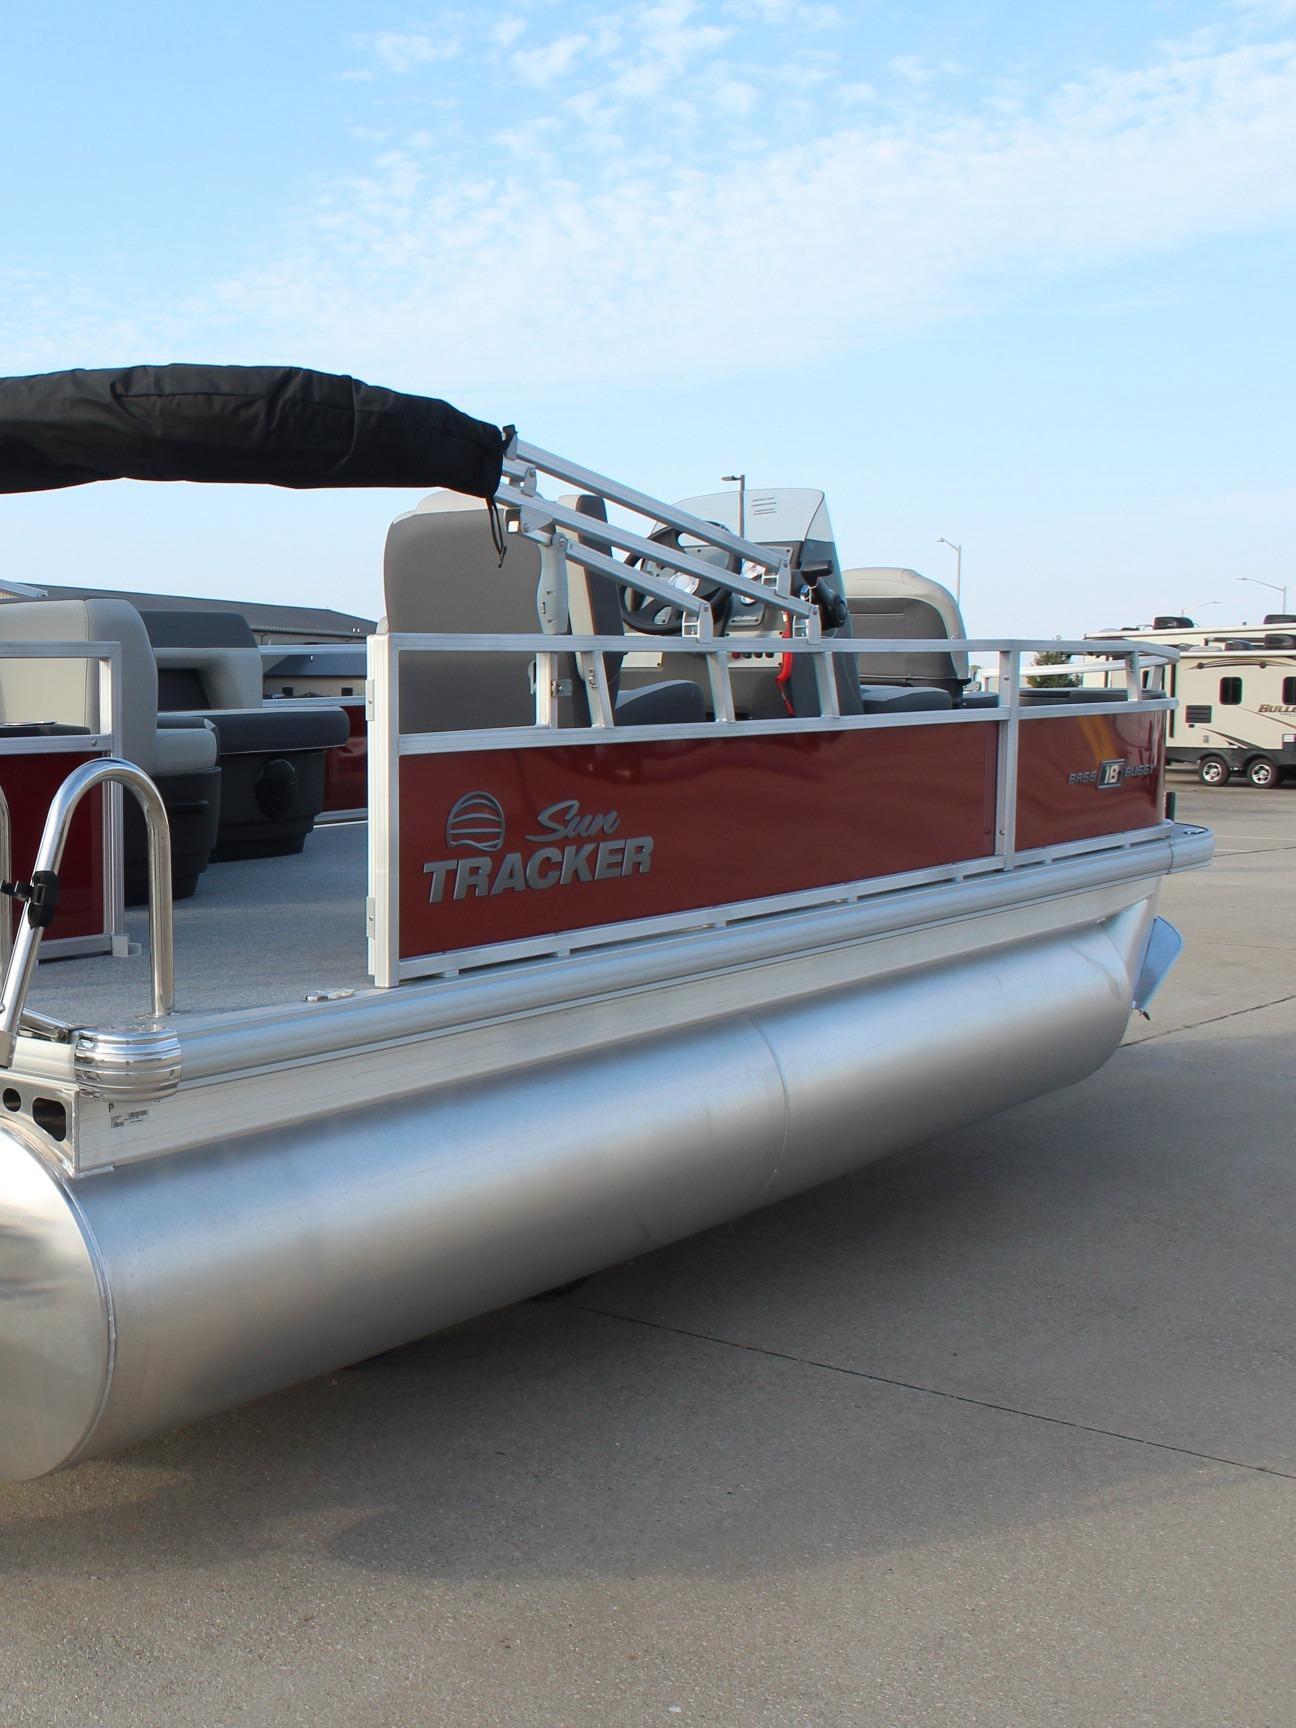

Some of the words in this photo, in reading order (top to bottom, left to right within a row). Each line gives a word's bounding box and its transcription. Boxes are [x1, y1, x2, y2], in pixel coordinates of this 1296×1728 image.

[1068, 771, 1097, 784] BASS
[1104, 765, 1120, 784] 18
[525, 800, 620, 842] Sun
[423, 836, 654, 904] TRACKER
